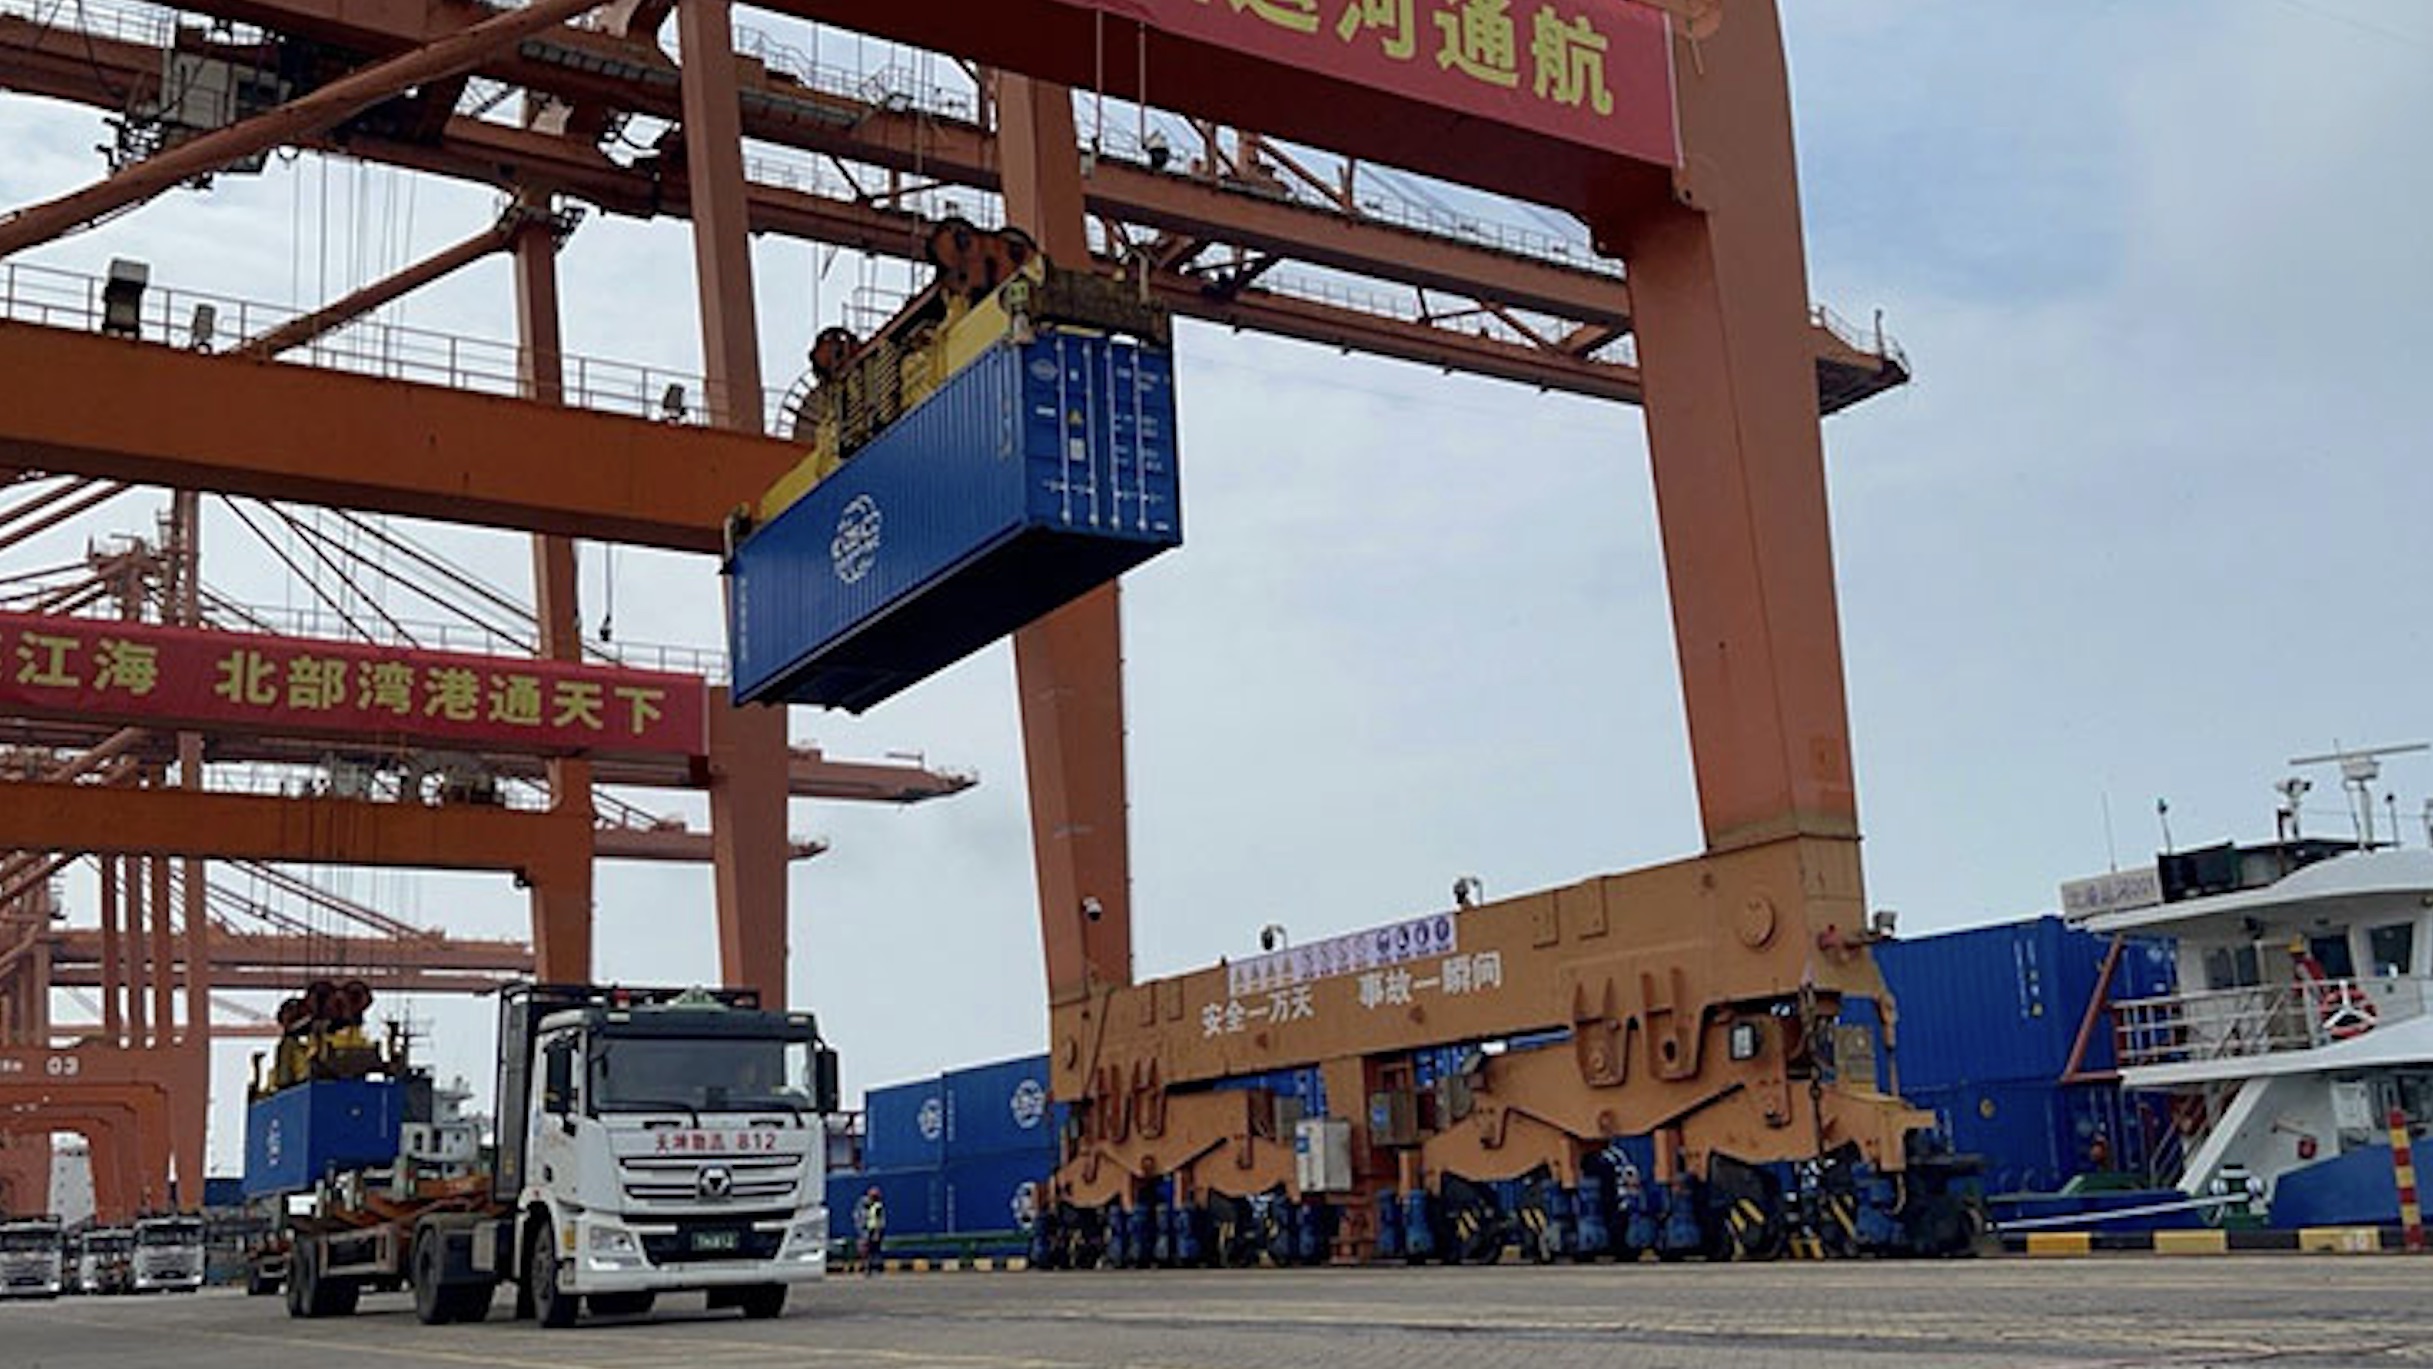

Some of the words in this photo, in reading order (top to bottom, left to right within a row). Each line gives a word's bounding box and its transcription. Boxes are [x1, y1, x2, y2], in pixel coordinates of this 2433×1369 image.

[16, 631, 159, 695] 江海
[215, 650, 666, 735] 北部湾港通天下
